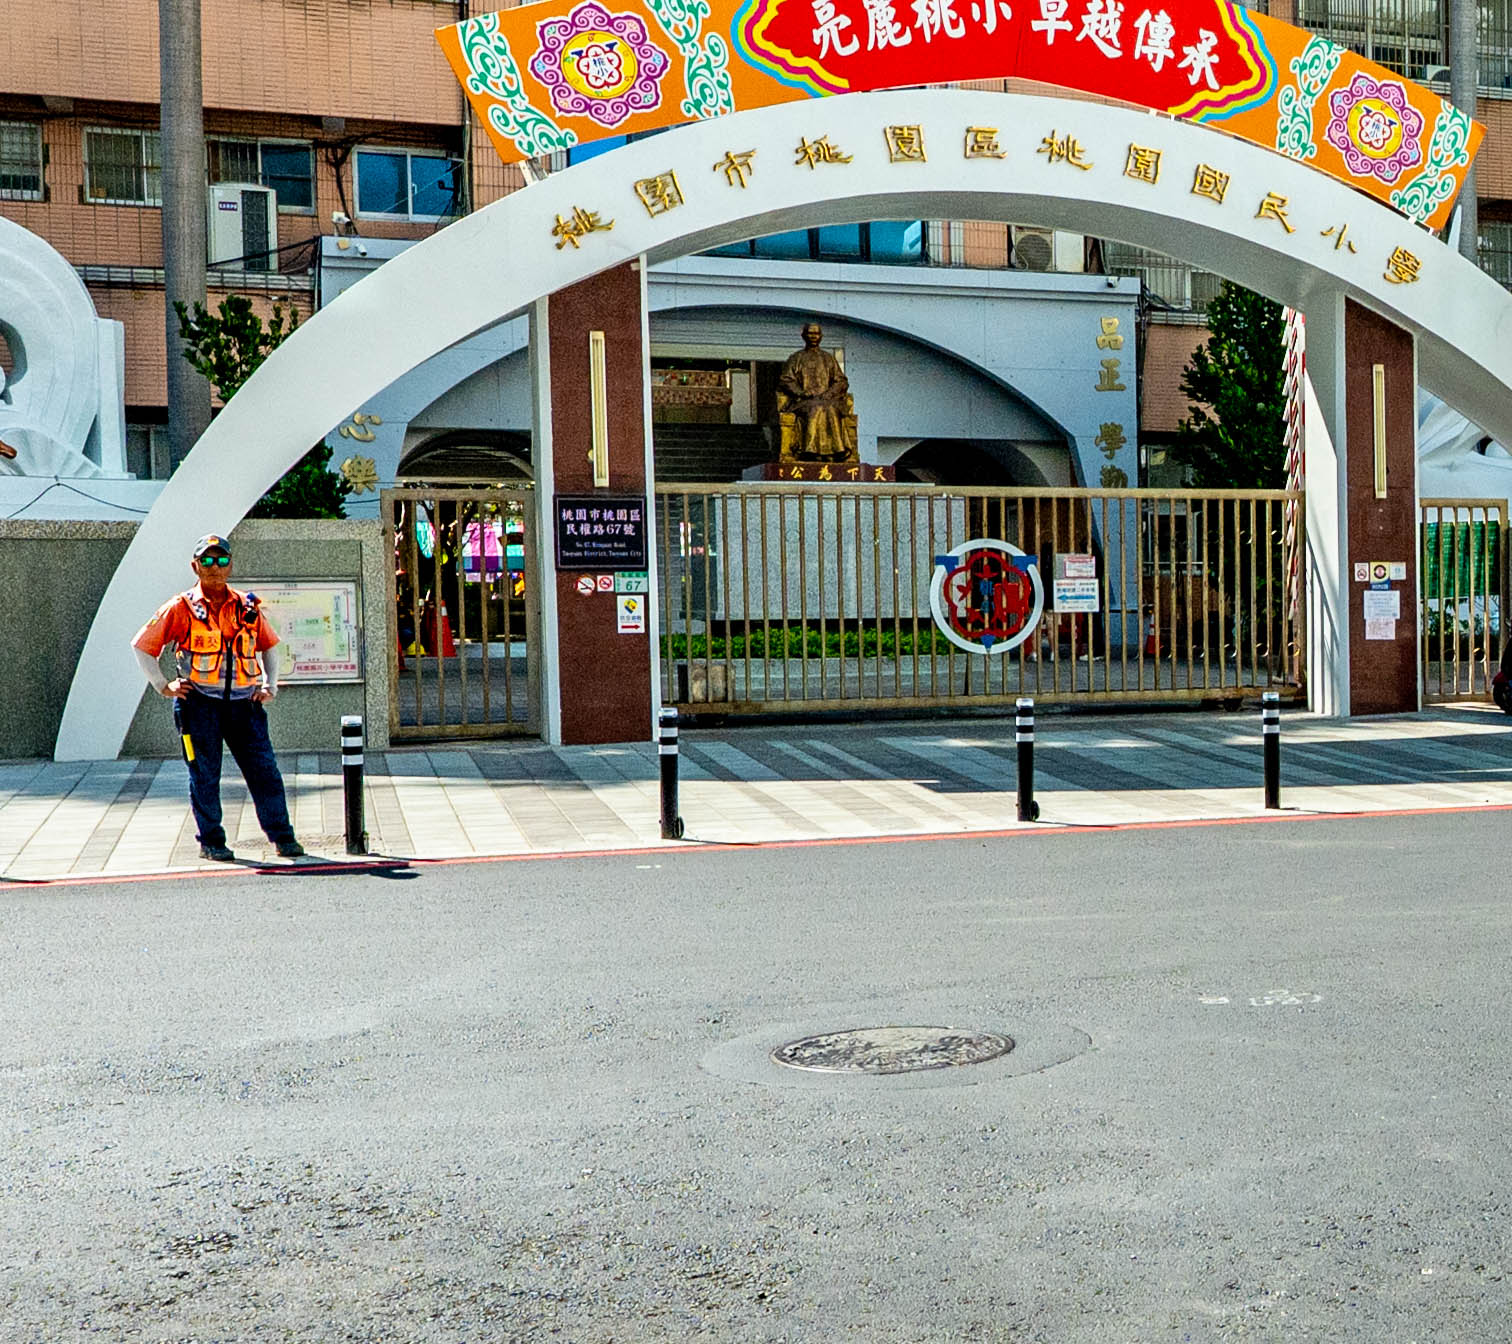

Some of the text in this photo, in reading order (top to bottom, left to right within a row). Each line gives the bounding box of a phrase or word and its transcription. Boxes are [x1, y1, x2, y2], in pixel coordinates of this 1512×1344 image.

[552, 124, 1423, 284] 桃園市桃園區桃園國民小學
[561, 508, 641, 522] 桃園市桃園區
[566, 523, 636, 536] 民權路67號
[625, 580, 641, 591] 67
